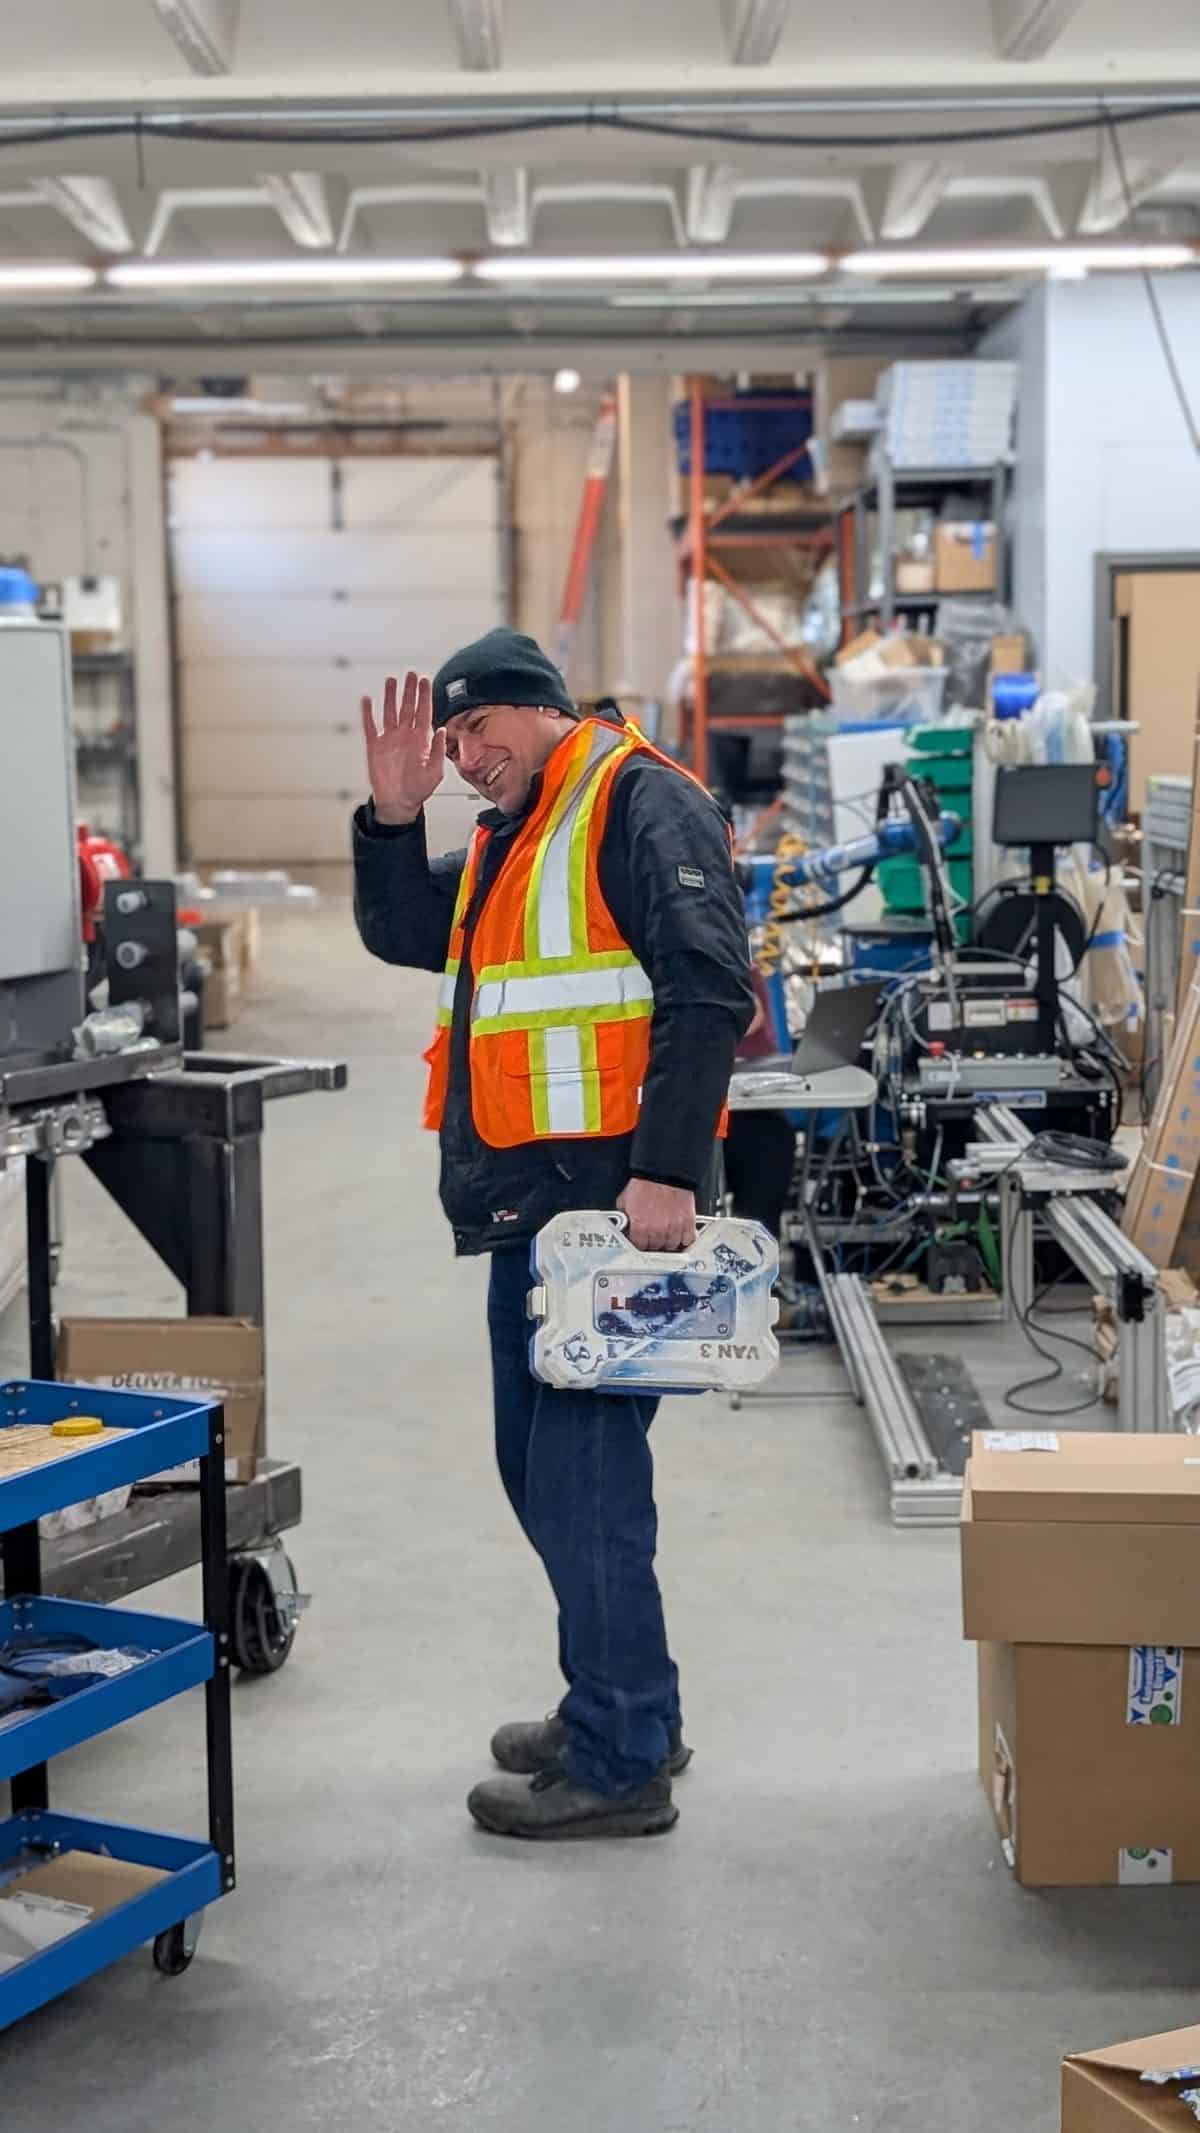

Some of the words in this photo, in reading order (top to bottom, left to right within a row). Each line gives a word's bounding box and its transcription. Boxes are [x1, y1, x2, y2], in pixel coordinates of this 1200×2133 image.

[700, 1343, 712, 1358] 3
[718, 1344, 760, 1360] VAN
[112, 1374, 182, 1389] DELIVER
